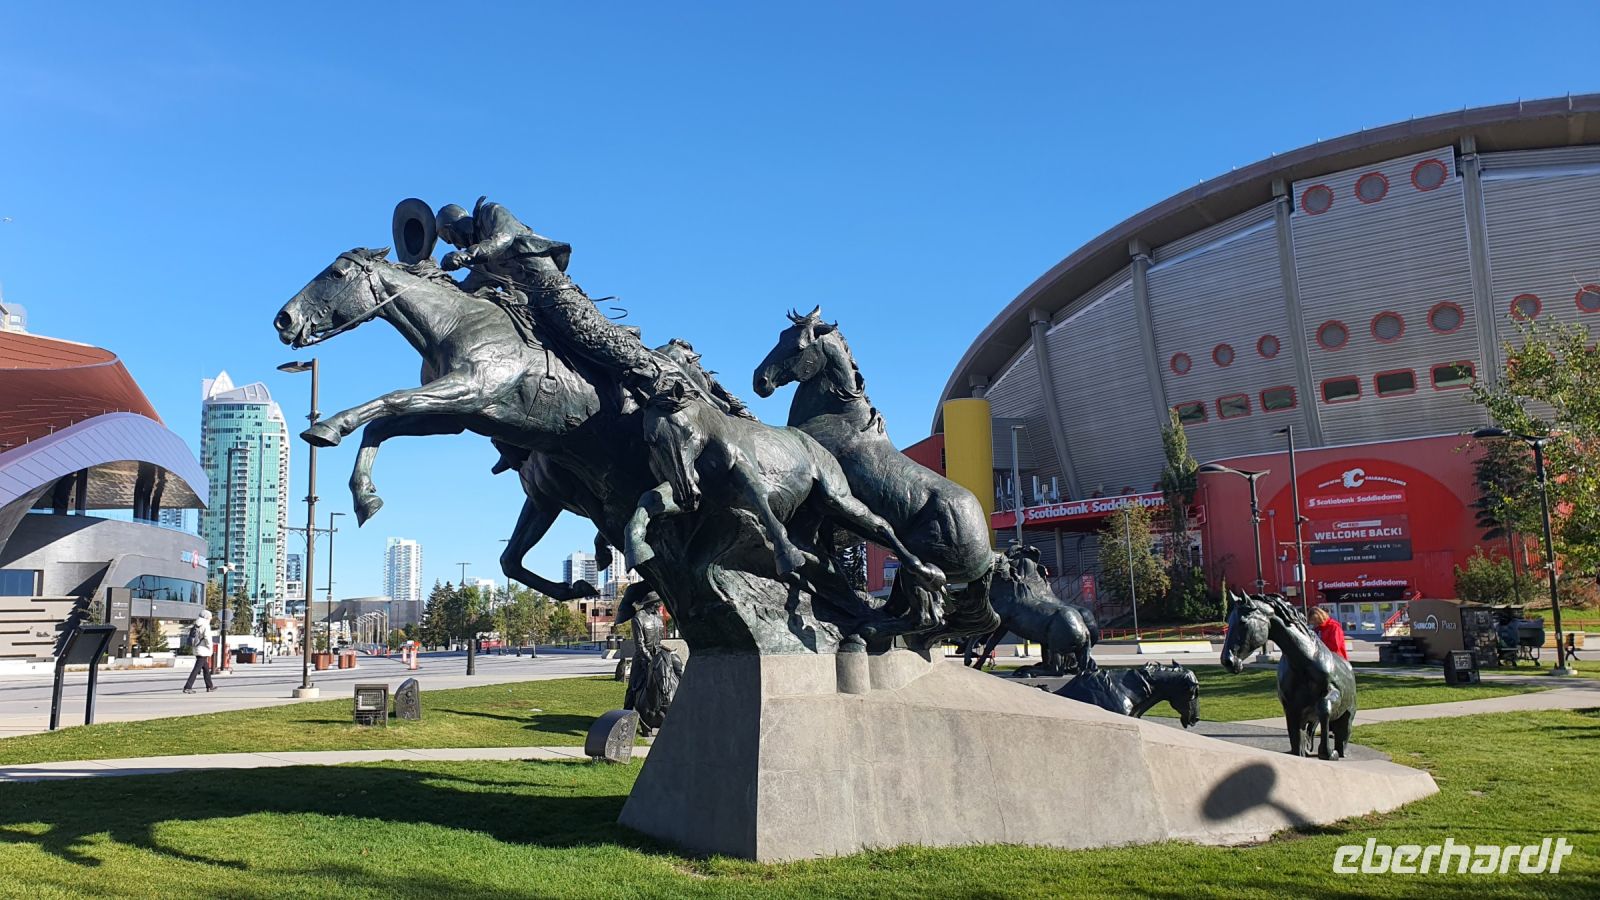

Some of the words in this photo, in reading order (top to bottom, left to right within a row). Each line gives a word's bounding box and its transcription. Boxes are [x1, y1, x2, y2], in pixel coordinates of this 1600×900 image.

[1316, 497, 1355, 505] Scotiabank
[1356, 493, 1402, 502] Saddledome
[1028, 502, 1088, 520] Scotiabank
[1092, 496, 1165, 513] Saddledom
[1314, 529, 1367, 541] WELCOME
[1368, 527, 1402, 538] BACK!
[1323, 580, 1359, 589] Scotiabank
[1361, 579, 1408, 587] Saddledome
[1441, 620, 1457, 630] Plaza
